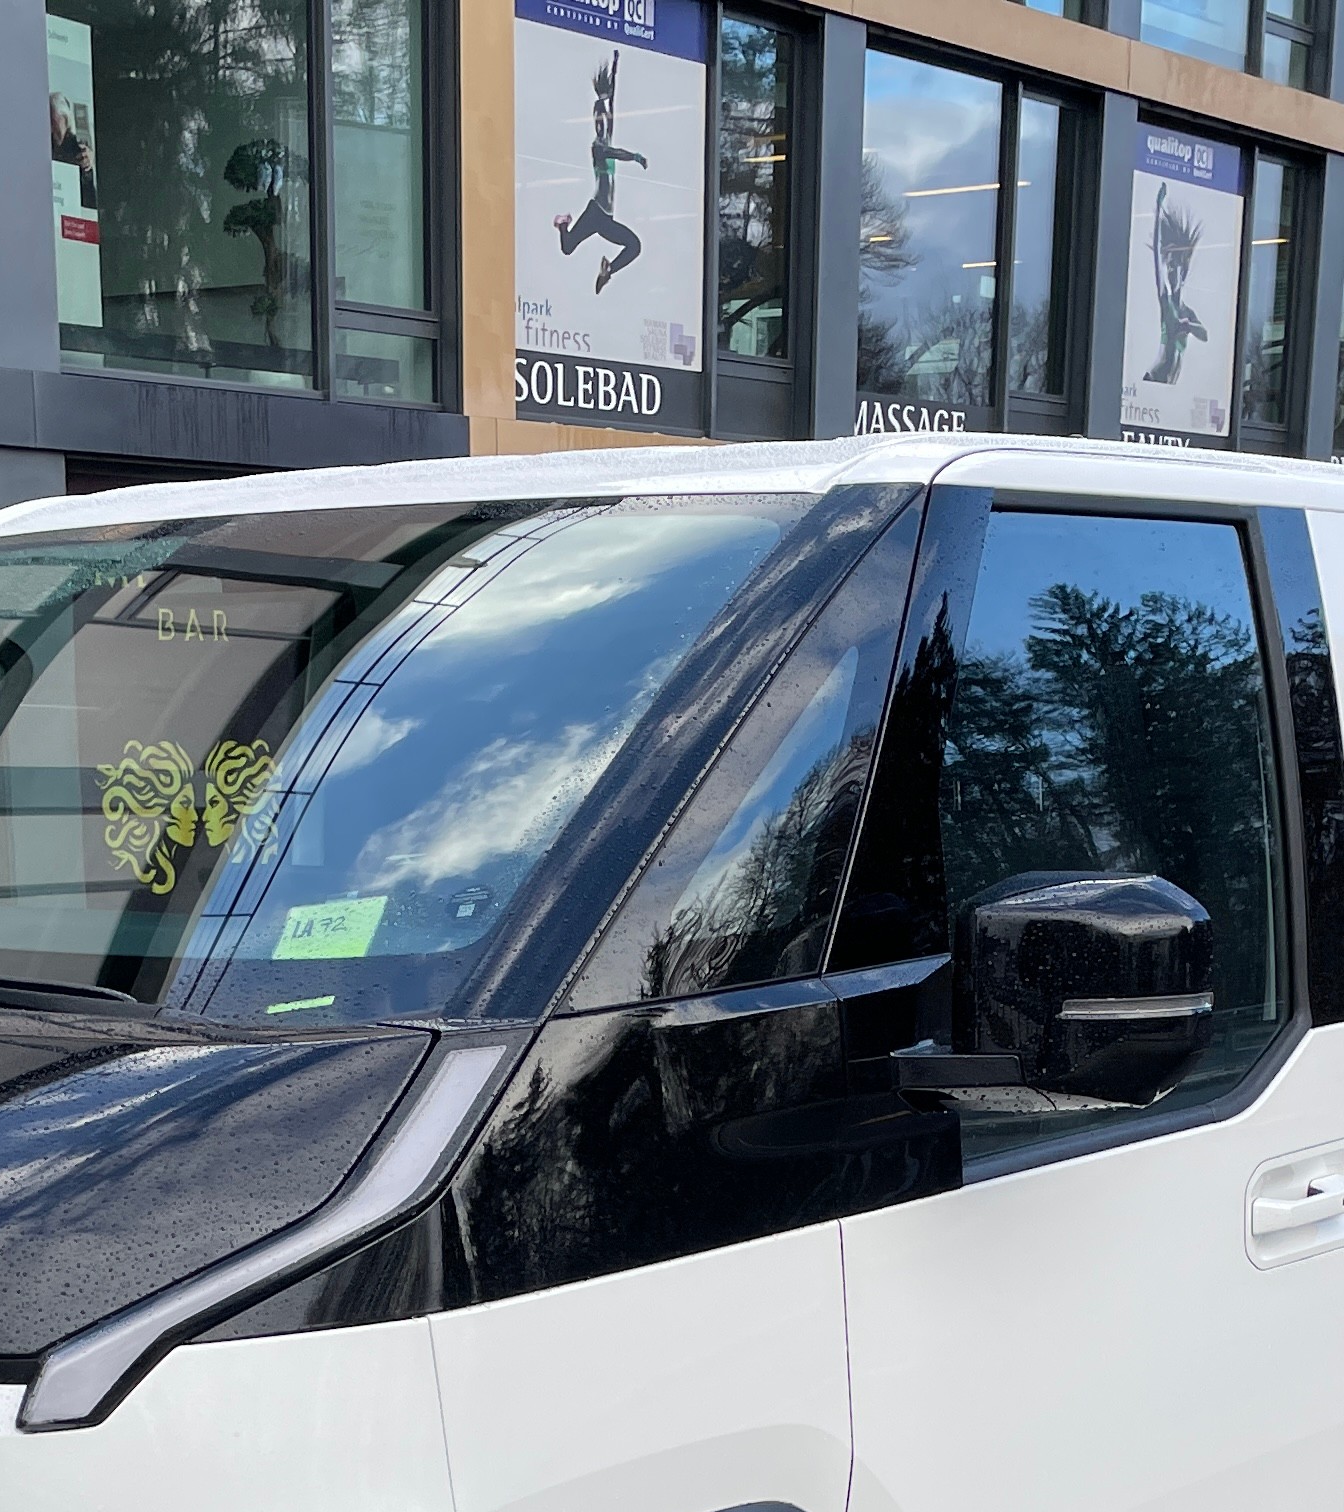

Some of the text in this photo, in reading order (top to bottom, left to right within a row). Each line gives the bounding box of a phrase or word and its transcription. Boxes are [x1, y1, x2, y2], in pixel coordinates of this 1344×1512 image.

[1147, 135, 1192, 163] qualitop
[525, 317, 591, 352] fitness
[516, 357, 662, 415] SOLEBAD
[854, 400, 966, 436] MASSAGE
[158, 608, 229, 642] BAR
[320, 916, 348, 931] 72
